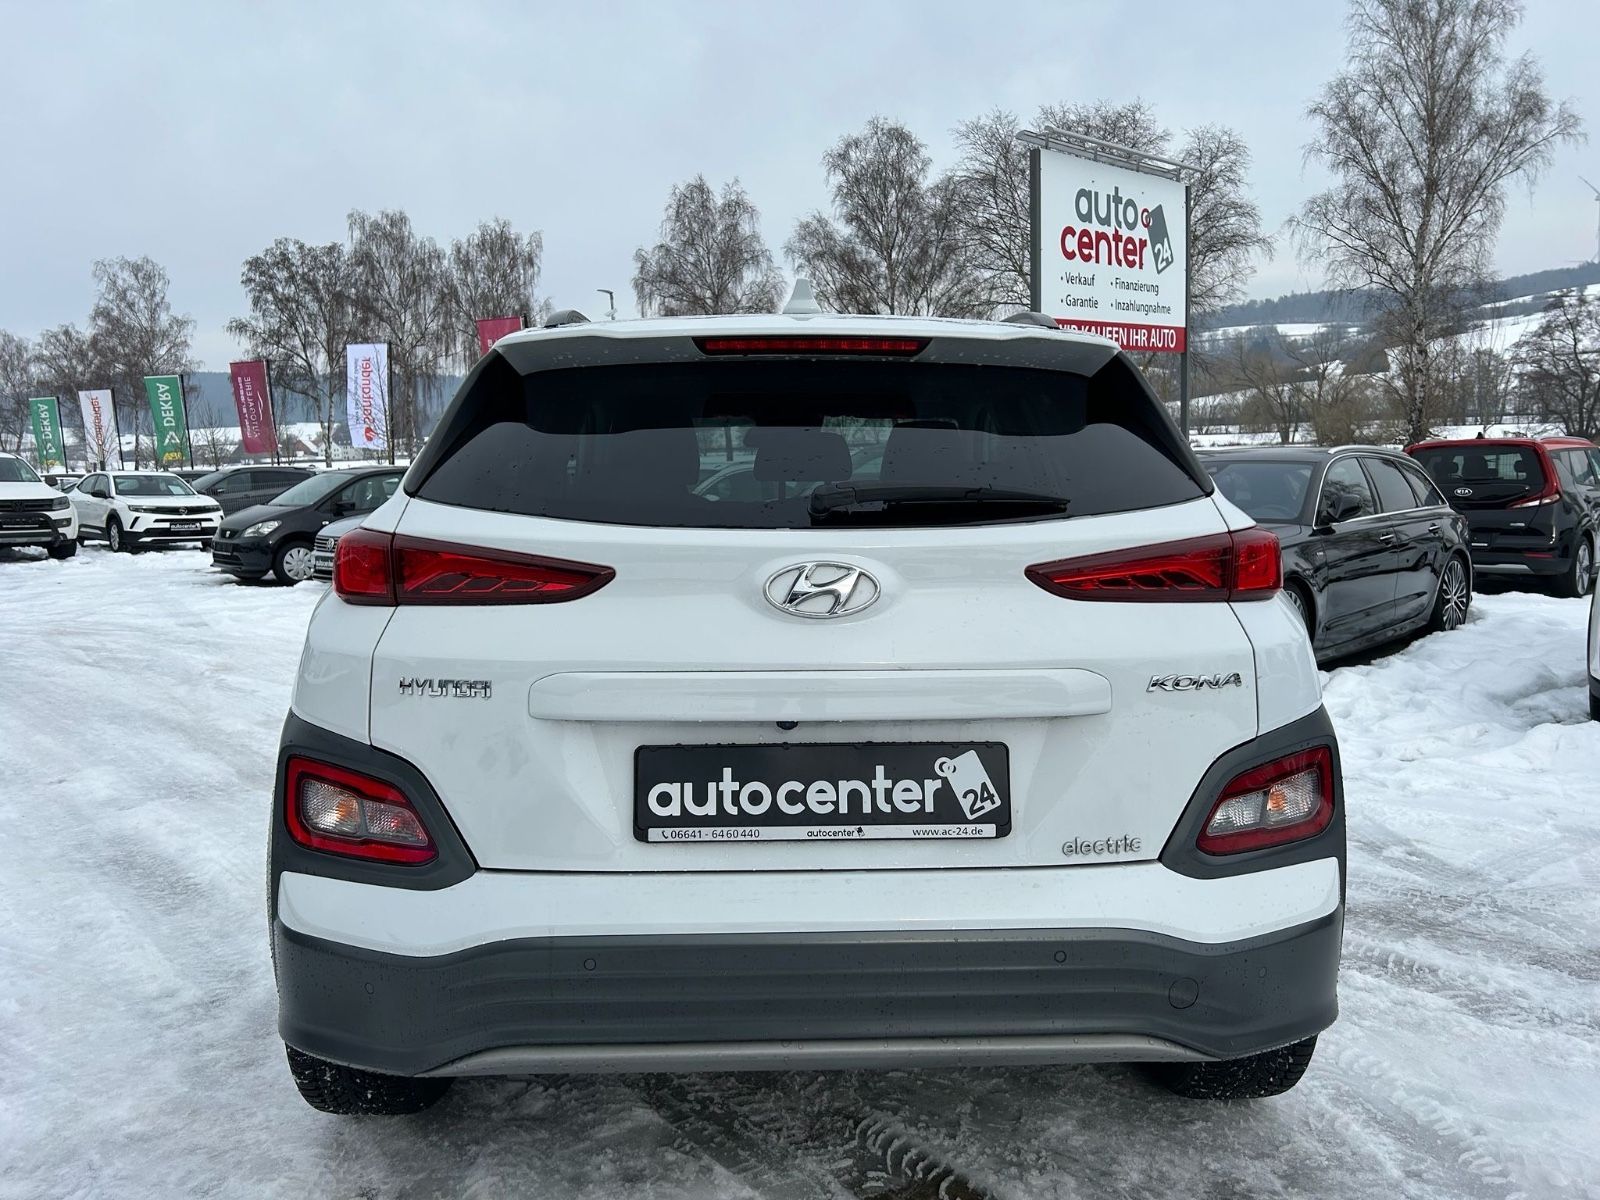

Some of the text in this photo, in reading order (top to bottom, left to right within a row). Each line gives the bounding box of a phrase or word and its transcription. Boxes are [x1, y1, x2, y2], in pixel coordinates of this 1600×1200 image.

[1075, 186, 1139, 231] auto
[1060, 226, 1147, 270] center
[1154, 238, 1173, 269] 24
[1065, 272, 1096, 287] Verkauf
[1114, 277, 1159, 296] Finanzierung
[1065, 294, 1099, 309] Garantie
[1114, 300, 1172, 316] Inzahlungnahme
[1129, 328, 1148, 347] IHR
[1149, 328, 1176, 348] AUTO
[399, 677, 493, 699] HYUNDAI
[1146, 672, 1242, 693] KONA
[962, 781, 996, 815] 24
[670, 830, 702, 839] 06641
[806, 828, 855, 838] autocenter
[912, 827, 984, 837] www.ac-24.de
[1062, 834, 1142, 857] electric
